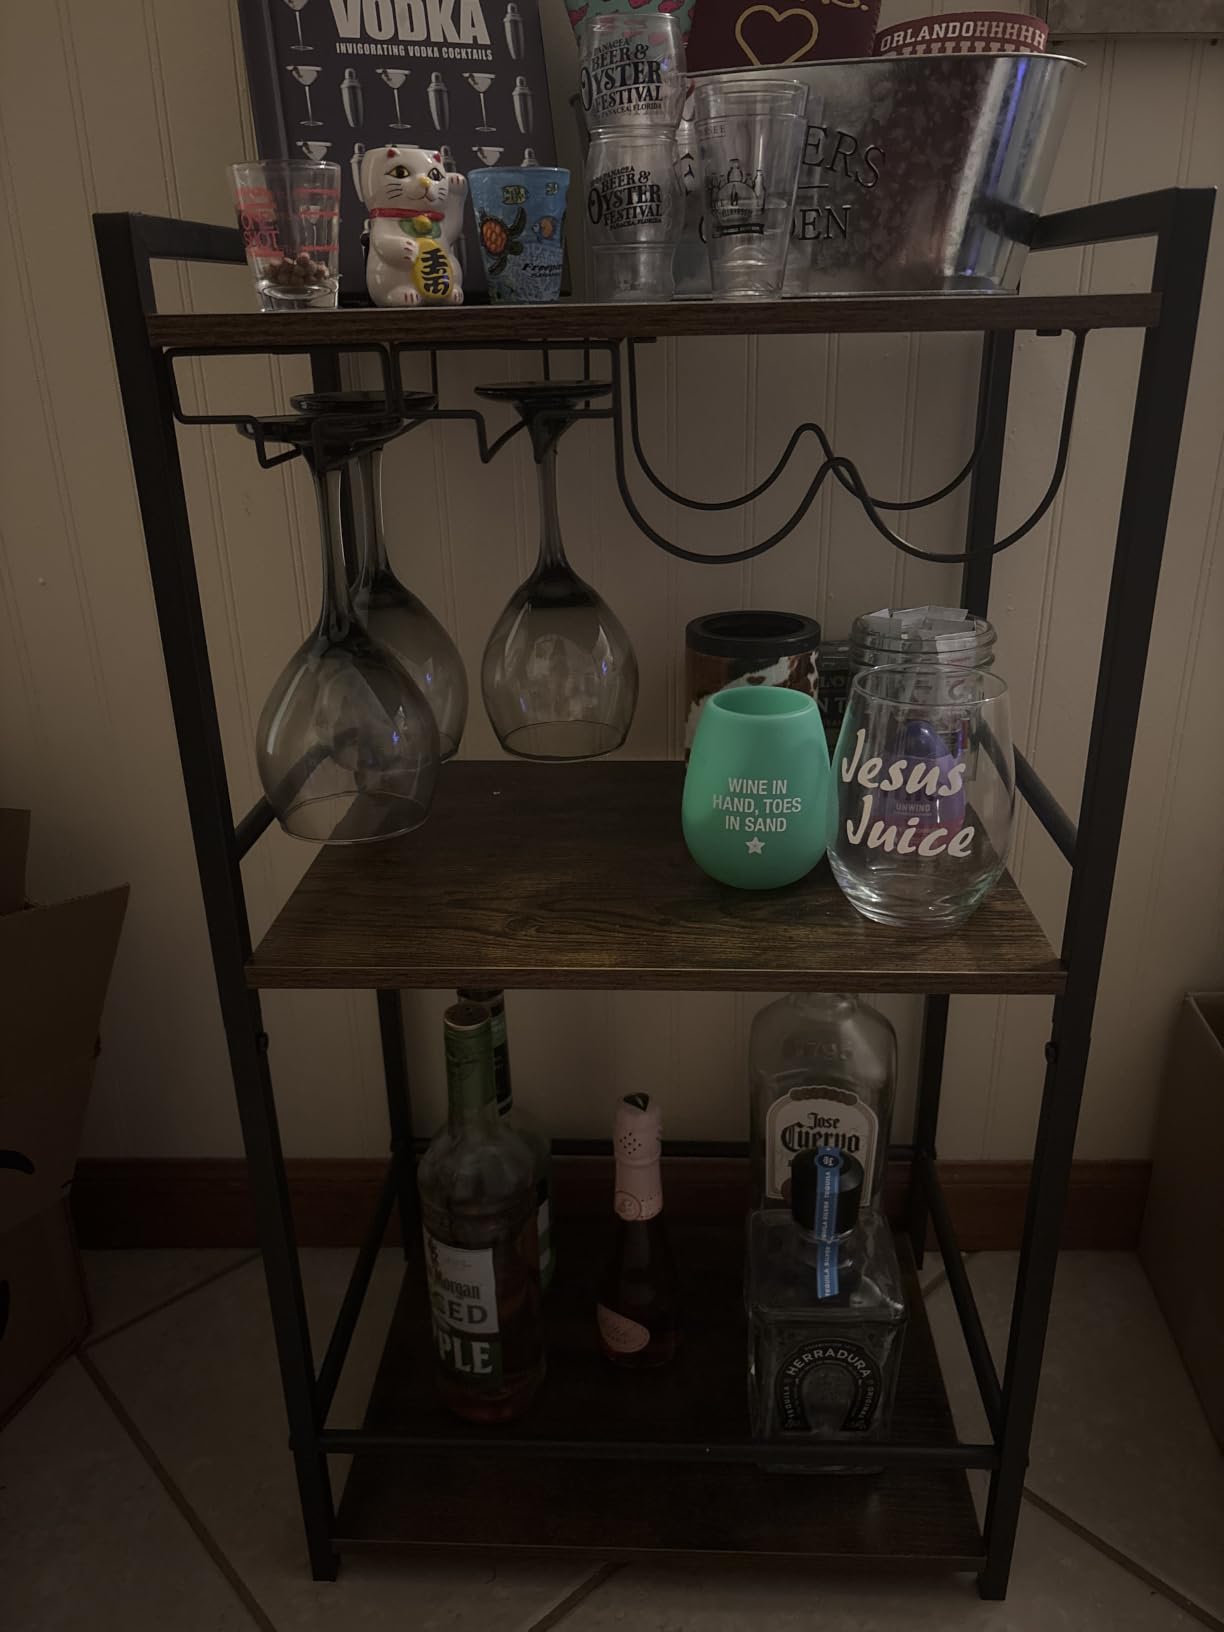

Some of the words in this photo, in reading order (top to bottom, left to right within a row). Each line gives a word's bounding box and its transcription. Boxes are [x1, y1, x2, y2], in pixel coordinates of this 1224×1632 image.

[329, 0, 491, 44] VODKA
[335, 42, 405, 57] INVIGORATING
[407, 45, 440, 58] VODKA
[442, 47, 493, 61] COCKTAILS
[591, 45, 631, 73] BEER
[634, 43, 649, 60] &
[580, 60, 663, 112] OYSTER
[592, 85, 664, 113] FESTIVAL
[633, 102, 662, 112] FLORIDA
[601, 172, 636, 193] BEER
[638, 170, 651, 185] &
[588, 184, 662, 225] OYSTER
[603, 203, 662, 227] FESTIVAL
[841, 727, 967, 797] Jesus
[728, 777, 769, 795] WINE
[772, 779, 788, 795] IN
[712, 794, 760, 816] HAND,
[763, 797, 802, 814] TOES
[894, 801, 932, 813] UNWIND
[725, 815, 740, 831] IN
[744, 816, 788, 832] SAND
[846, 794, 976, 858] Juice
[807, 1112, 841, 1130] Jose
[781, 1121, 861, 1154] Cuervo
[785, 1346, 872, 1378] HERRADURA
